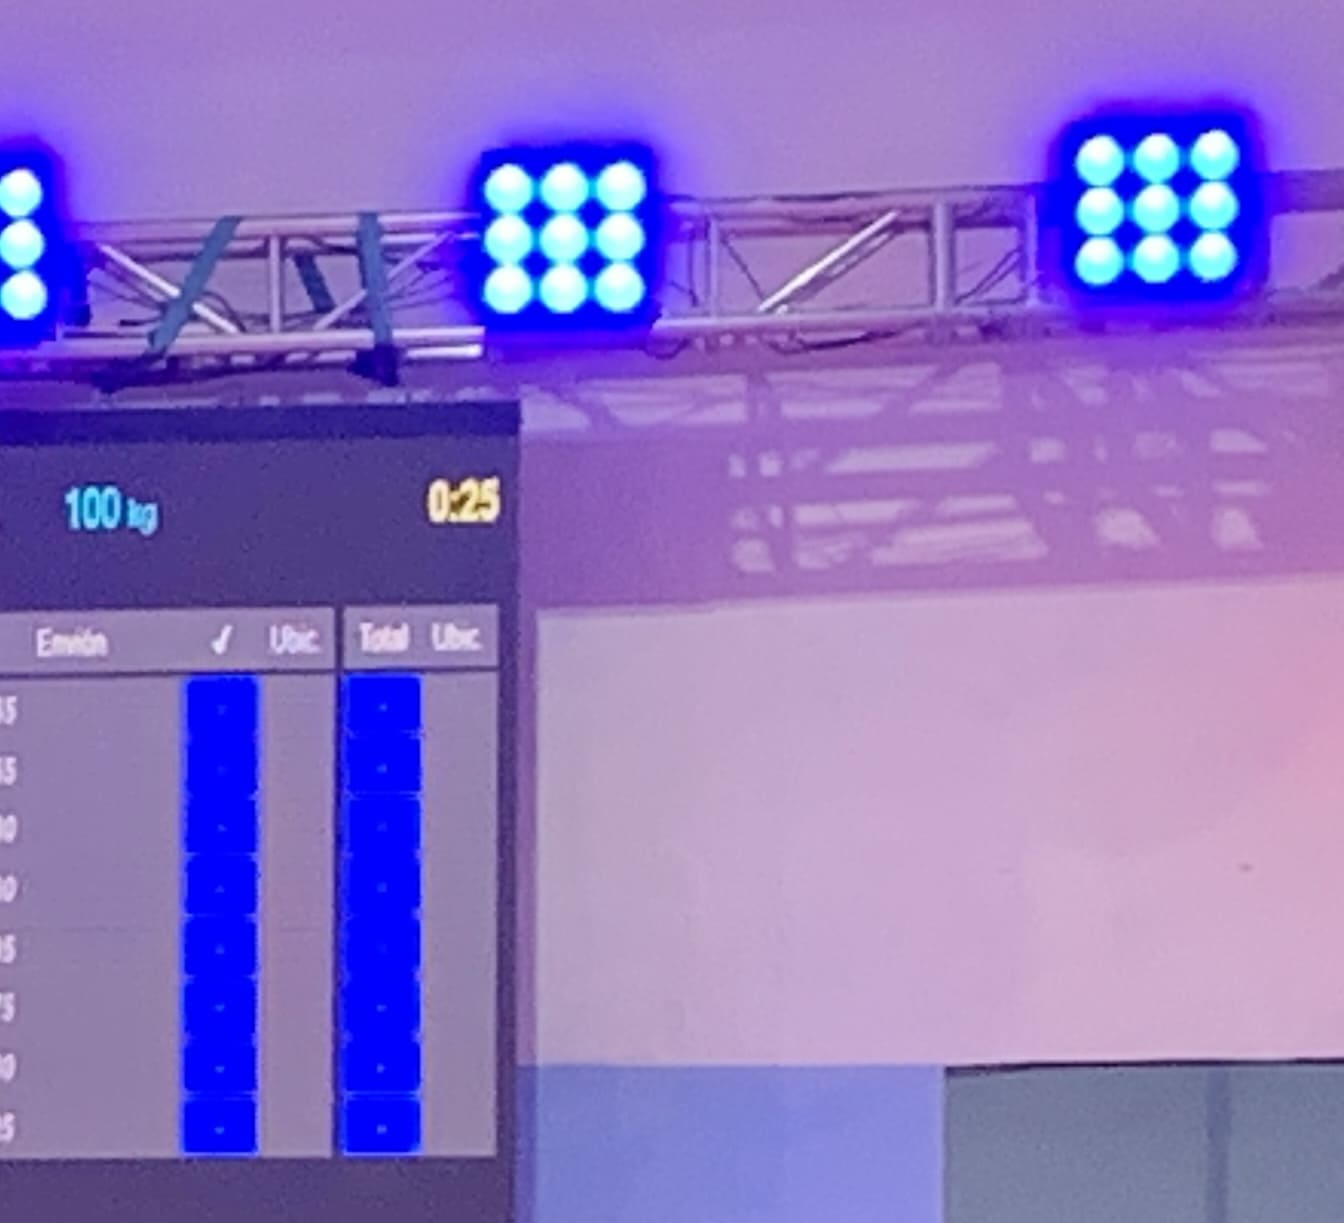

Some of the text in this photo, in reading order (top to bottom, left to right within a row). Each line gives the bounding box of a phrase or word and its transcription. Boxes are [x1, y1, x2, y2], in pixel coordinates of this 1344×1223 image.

[64, 486, 159, 536] 100 kg
[427, 477, 500, 524] 0:25
[359, 623, 411, 653] Total
